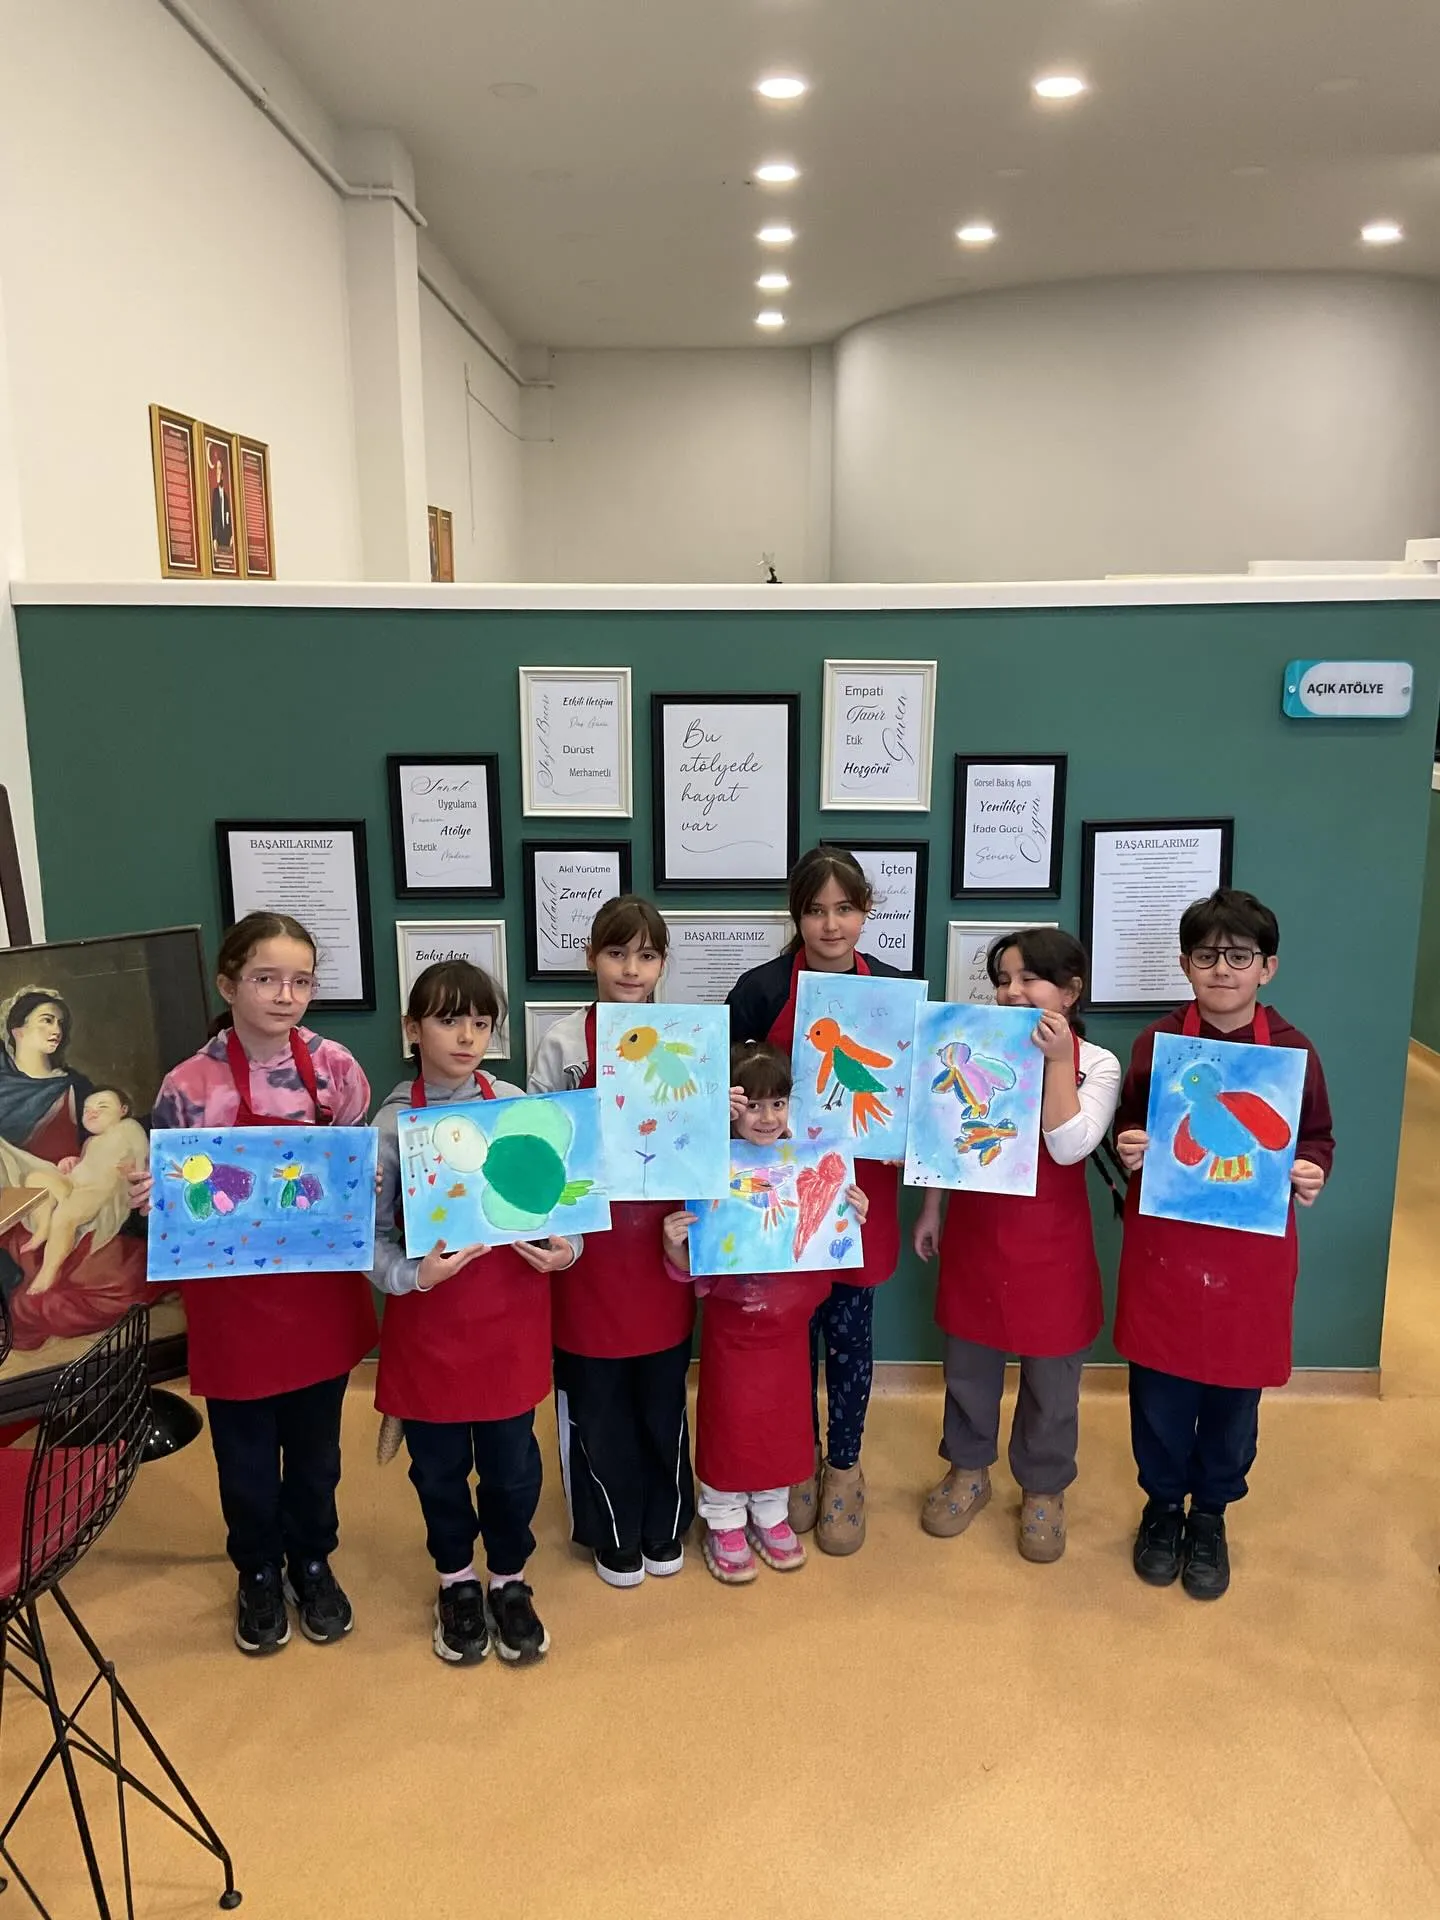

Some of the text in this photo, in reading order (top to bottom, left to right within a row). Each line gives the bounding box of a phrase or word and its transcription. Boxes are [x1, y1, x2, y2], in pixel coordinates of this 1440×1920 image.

[845, 685, 884, 698] Empati
[1306, 681, 1384, 696] AÇIK ATÖLYE
[562, 696, 584, 706] Etkili
[846, 705, 886, 724] Tavır
[682, 718, 722, 749] Bu
[846, 734, 863, 745] Etik
[569, 767, 612, 778] Merhametli
[680, 752, 763, 786] atölyede
[843, 762, 891, 779] Hoşgörü
[973, 778, 1032, 788] Görsel Bakış Açısı
[437, 799, 478, 811] Uygulama
[681, 782, 749, 816] hayat
[980, 799, 1027, 815] Yenilikçi
[440, 824, 472, 840] Atölye
[681, 821, 719, 832] var
[972, 822, 997, 833] İfade
[249, 839, 334, 850] BAŞARILARIMIZ
[412, 842, 438, 852] Estetik
[1114, 838, 1200, 850] BAŞARILARIMIZ
[558, 865, 574, 873] Akıl
[880, 860, 913, 876] İçten
[560, 887, 603, 901] Zarafet
[867, 908, 912, 920] Samimi
[684, 931, 765, 942] BAŞARILARIMIZ
[878, 931, 906, 949] Özel
